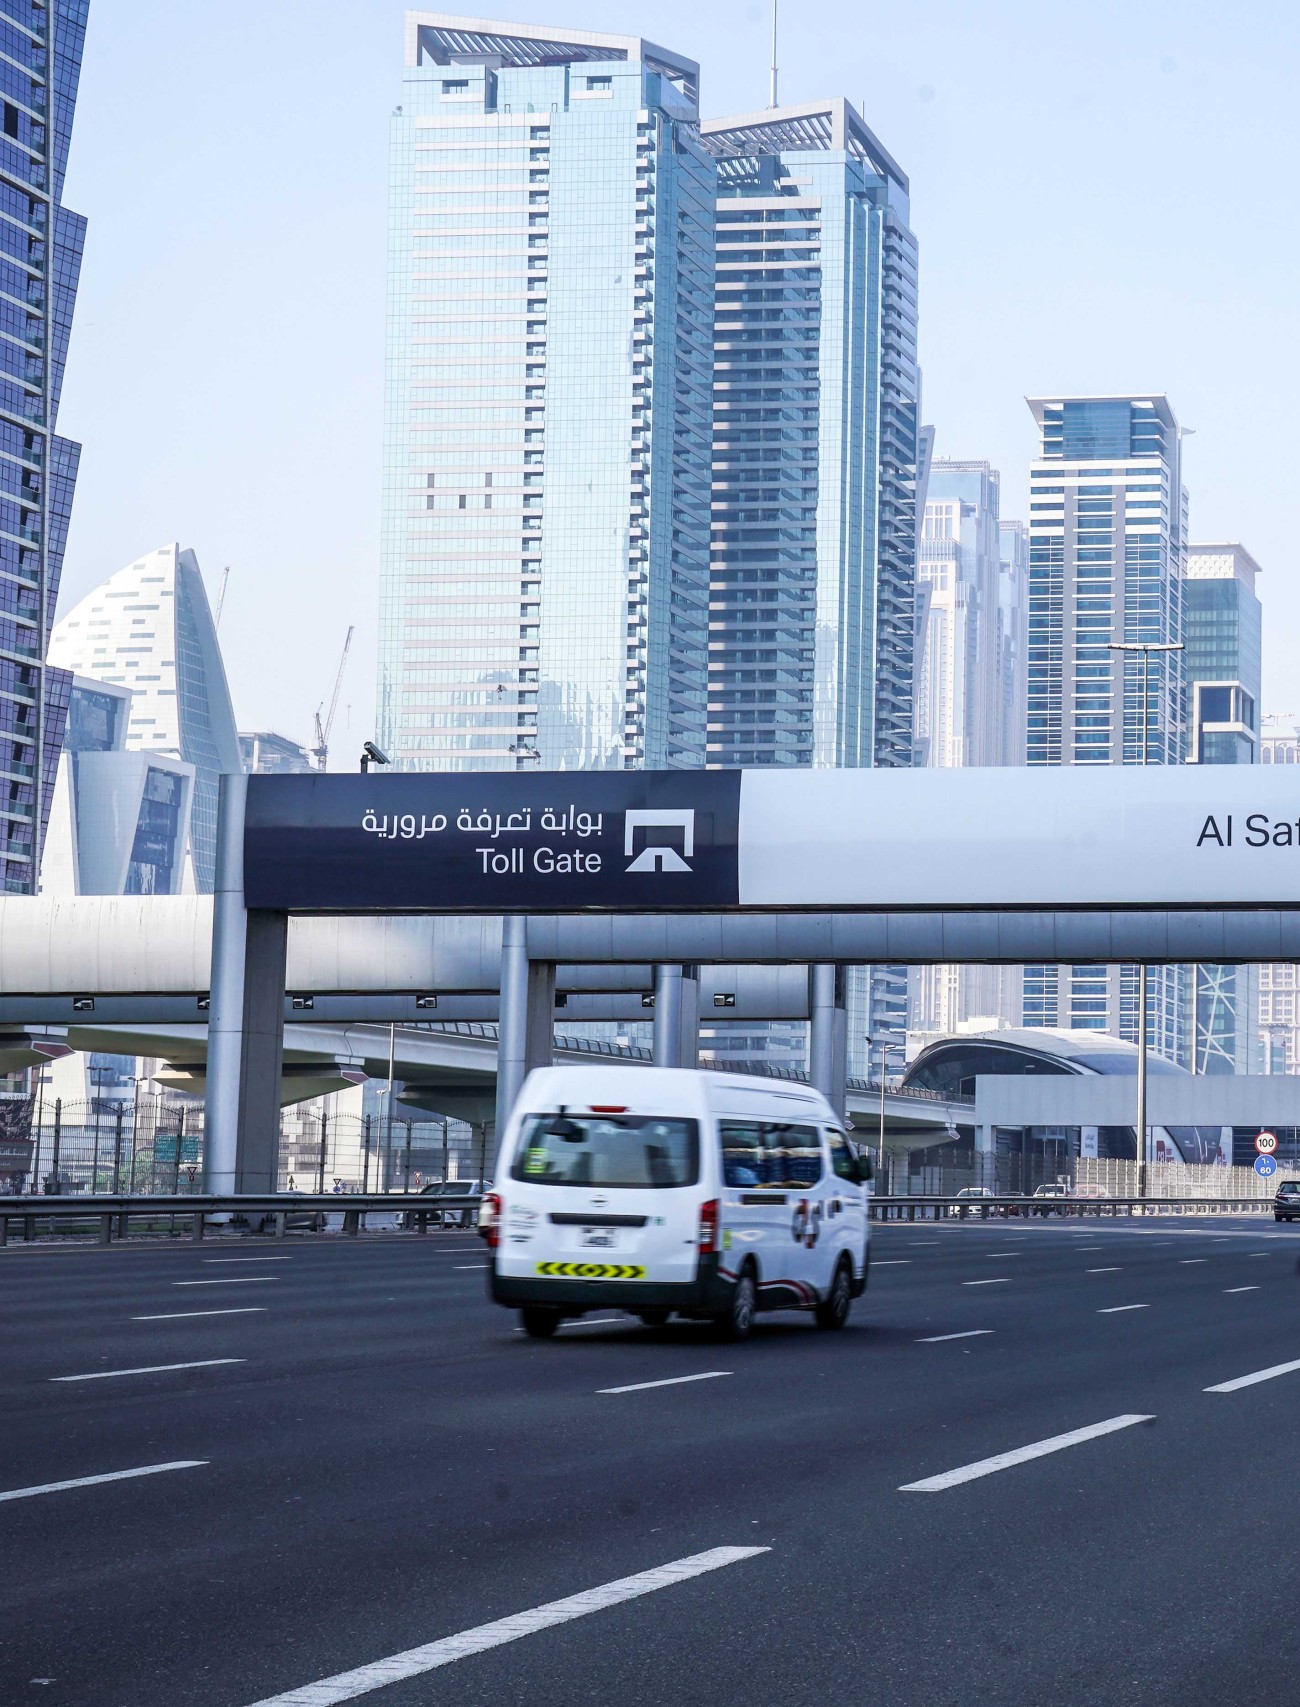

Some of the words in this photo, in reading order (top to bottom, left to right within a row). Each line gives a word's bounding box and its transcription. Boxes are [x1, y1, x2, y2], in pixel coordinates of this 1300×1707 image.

[362, 808, 448, 839] مرورية
[456, 807, 531, 839] تعرفة
[541, 804, 603, 837] بوابة
[1196, 815, 1232, 847] Al
[476, 847, 524, 874] Toll
[533, 847, 602, 874] Gate
[1259, 1138, 1274, 1147] 100
